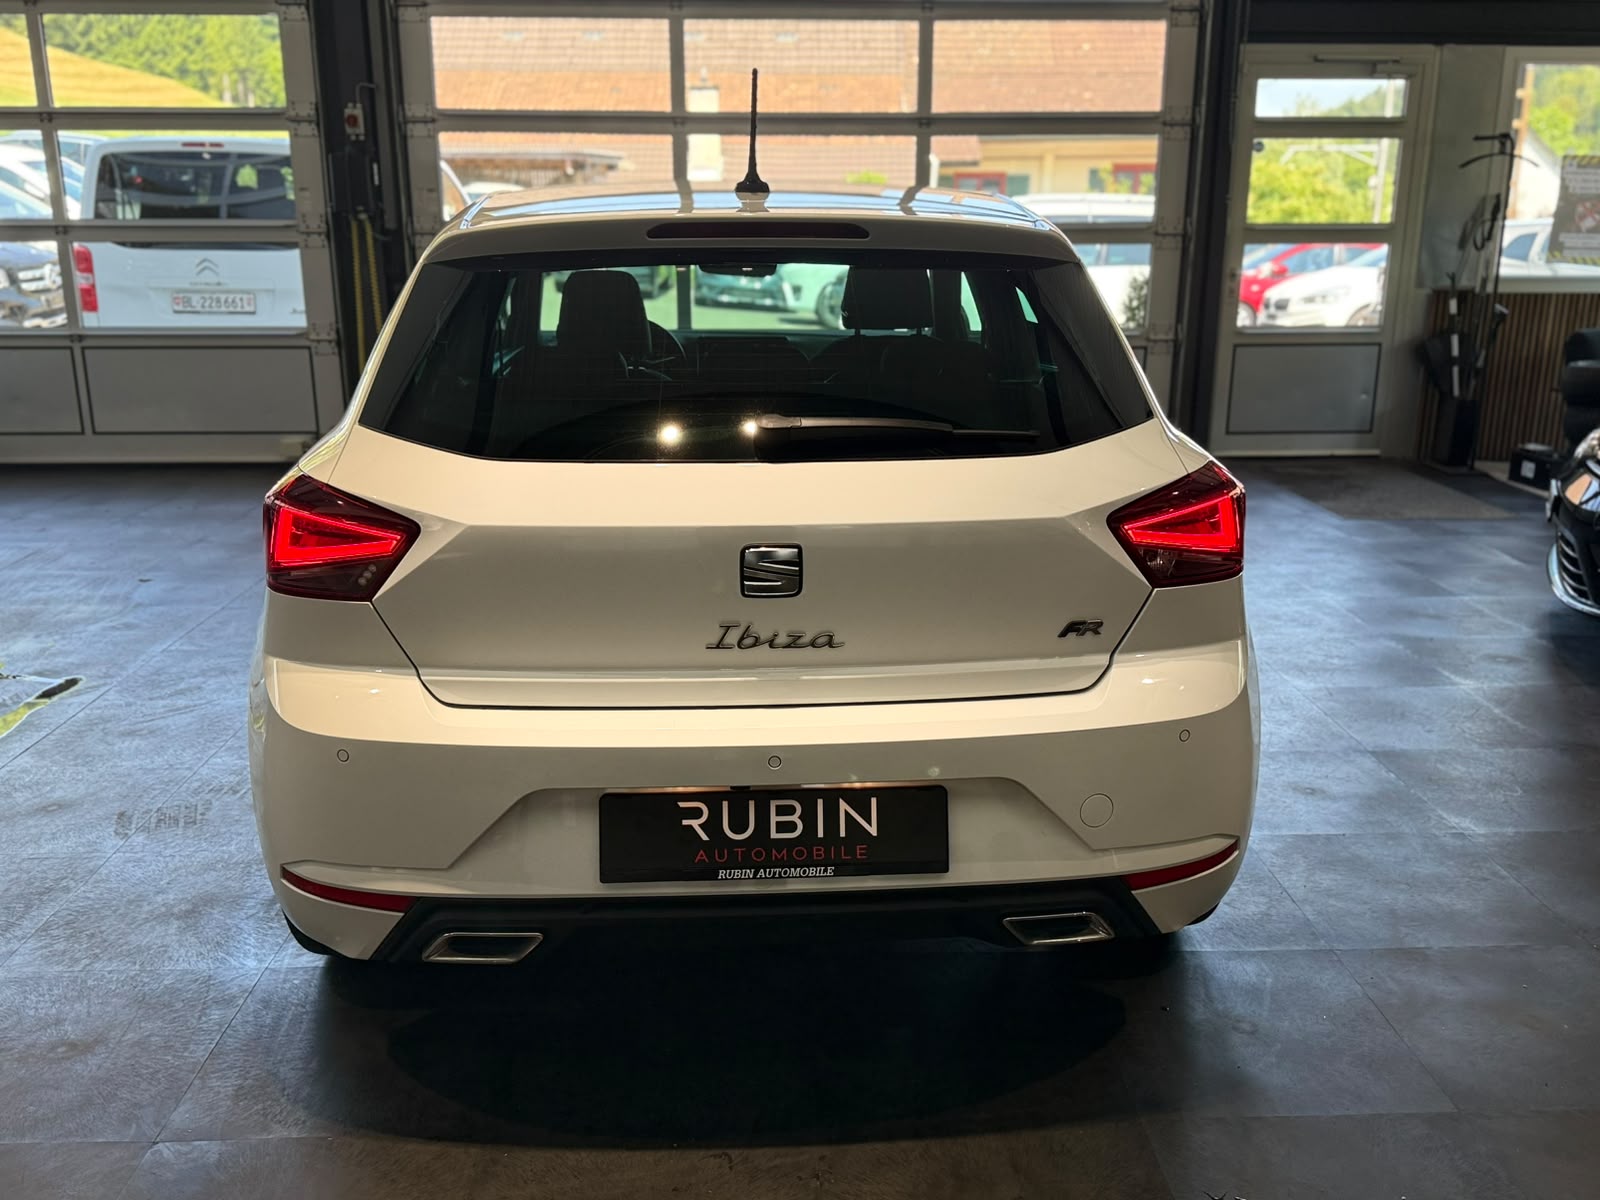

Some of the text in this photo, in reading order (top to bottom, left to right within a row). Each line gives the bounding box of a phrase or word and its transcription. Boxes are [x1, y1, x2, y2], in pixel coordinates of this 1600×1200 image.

[705, 621, 845, 650] Ibiza
[1057, 619, 1104, 638] FR
[677, 797, 878, 841] RUBIN
[694, 844, 868, 864] AUTOMOBILE
[717, 866, 835, 880] RUBIN AUTOMOBILE
